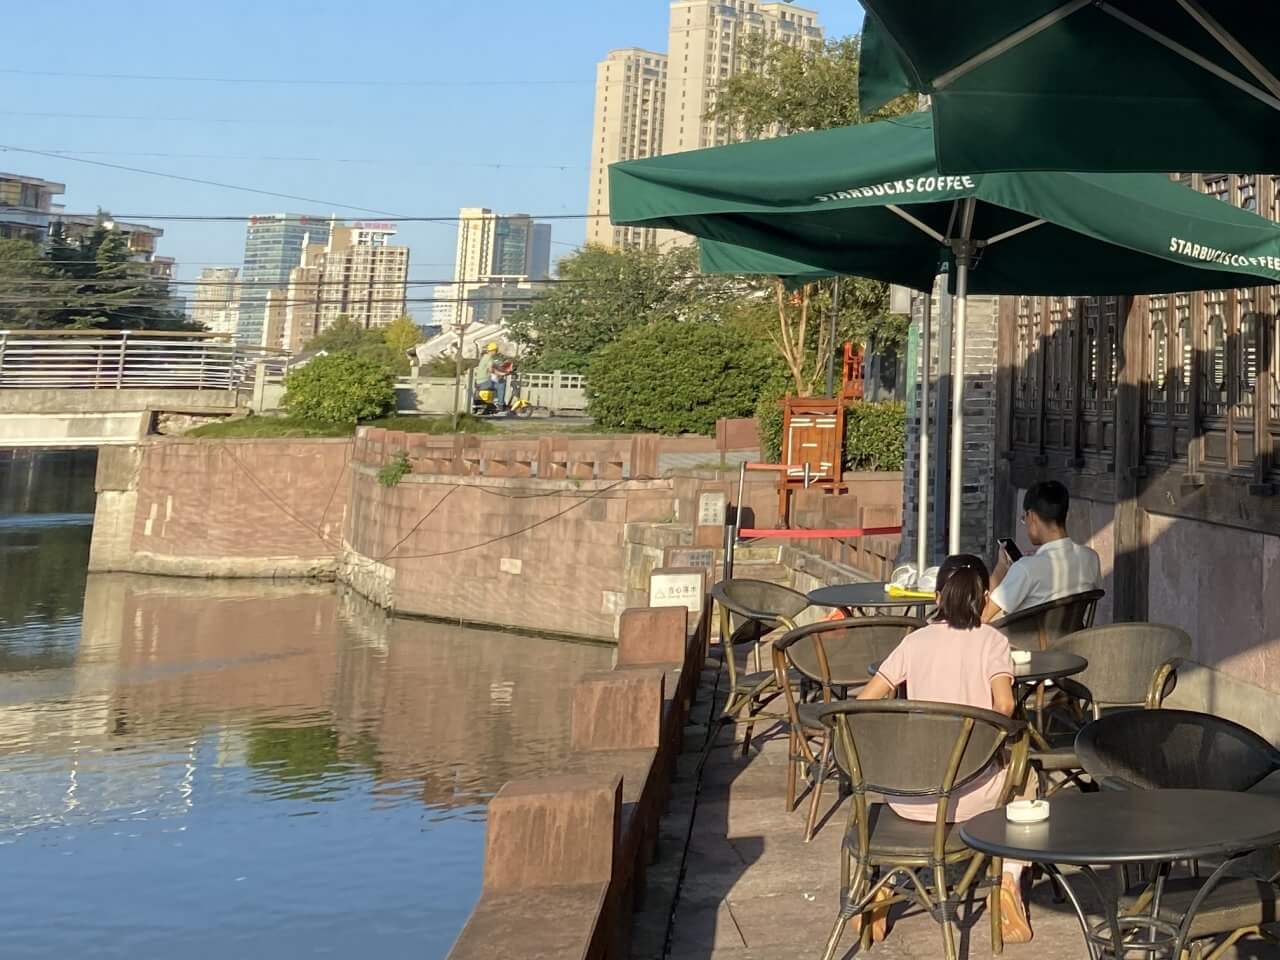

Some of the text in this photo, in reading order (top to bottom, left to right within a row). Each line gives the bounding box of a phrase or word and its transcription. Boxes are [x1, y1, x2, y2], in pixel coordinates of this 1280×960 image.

[815, 175, 975, 202] STARBUCKS COFFEE
[1169, 237, 1280, 271] STARBUCKS COFFEE
